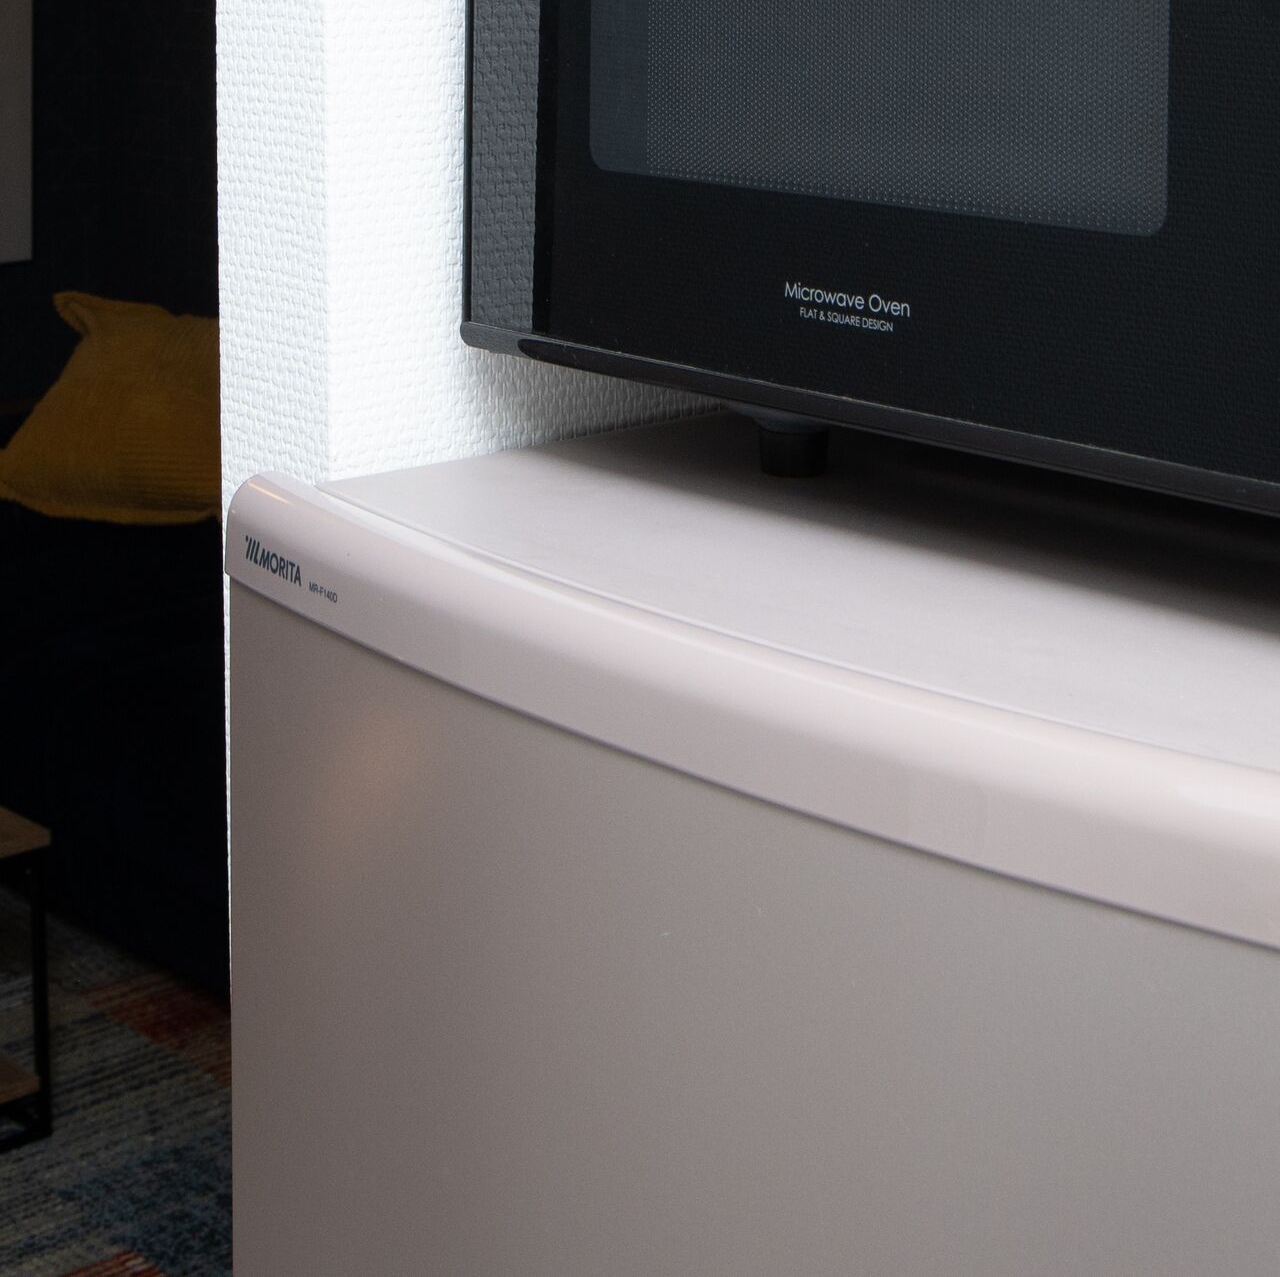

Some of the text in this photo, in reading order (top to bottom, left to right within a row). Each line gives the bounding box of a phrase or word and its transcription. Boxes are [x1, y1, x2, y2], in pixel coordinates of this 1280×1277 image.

[784, 281, 911, 318] Microwave Oven
[799, 306, 894, 332] FLAT & SQUARE DESIGN
[259, 548, 302, 588] MORITA
